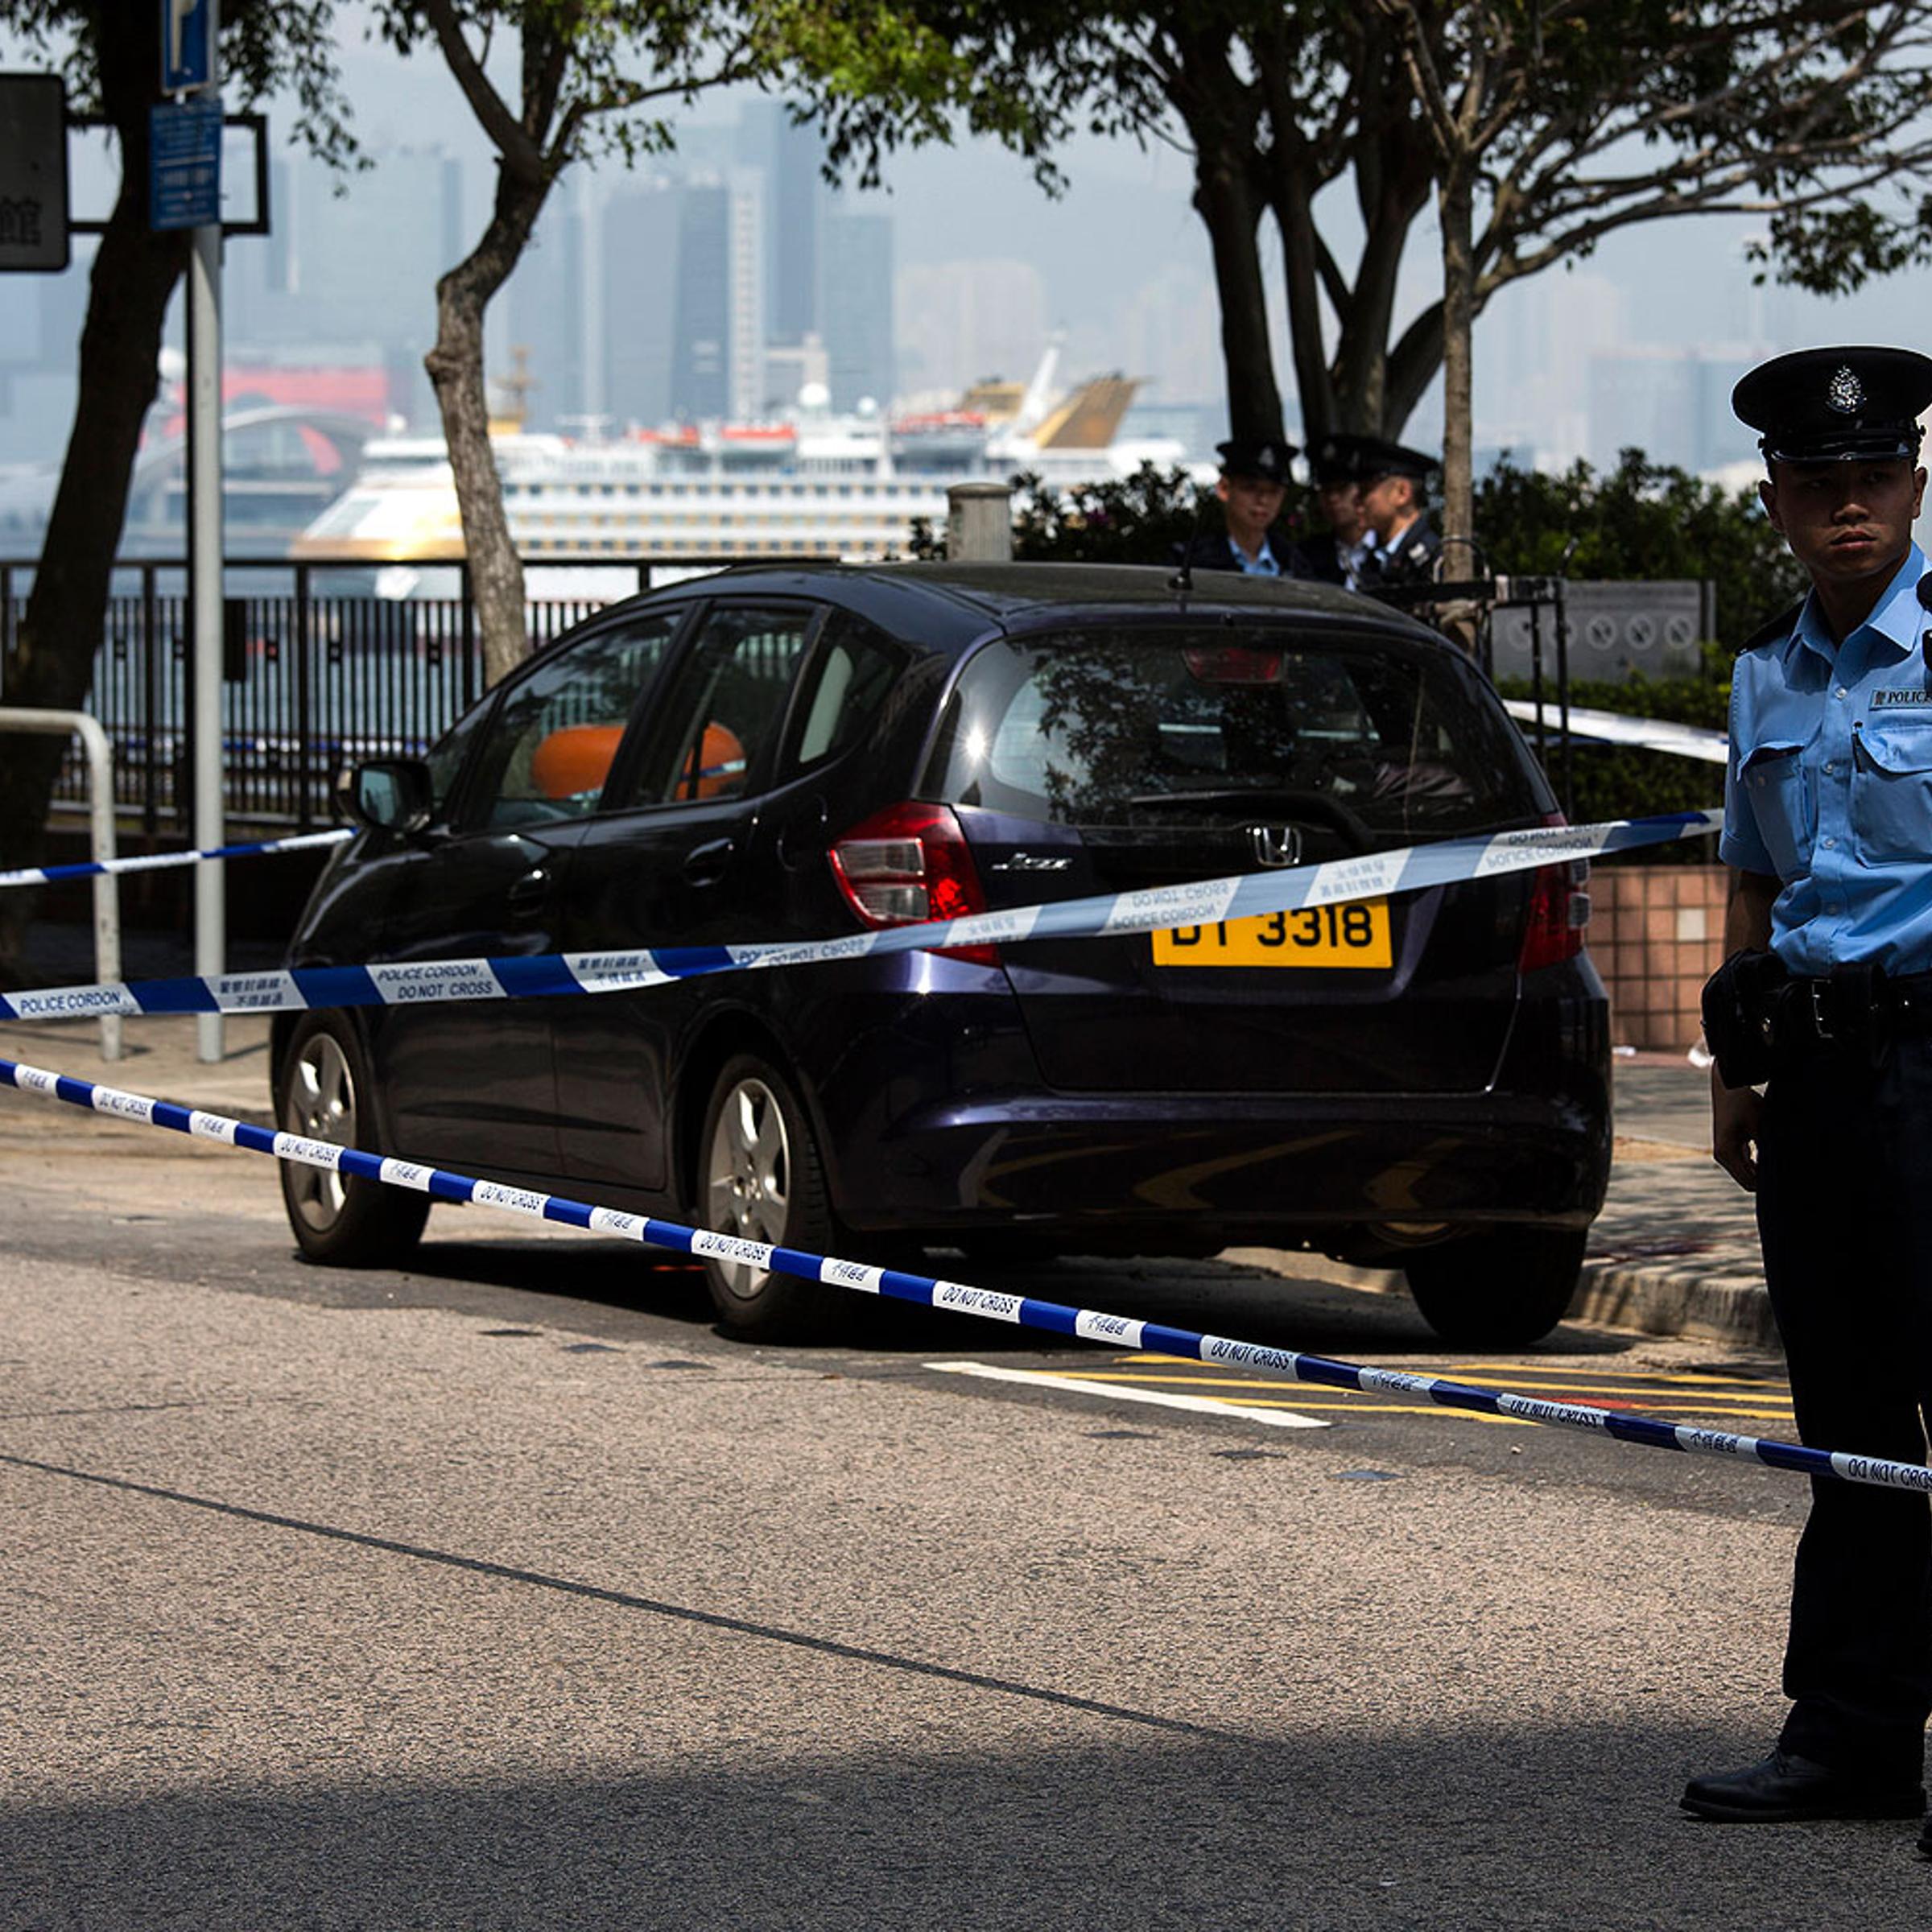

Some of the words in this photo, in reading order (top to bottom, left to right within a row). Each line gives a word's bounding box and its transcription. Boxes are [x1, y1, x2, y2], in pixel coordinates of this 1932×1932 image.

[1257, 903, 1373, 947] 3318
[378, 967, 423, 981] POLICE
[398, 985, 416, 999] DO
[419, 983, 444, 997] NOT
[449, 980, 493, 996] CROSS
[20, 995, 64, 1013] POLICE
[943, 1286, 962, 1302] DO
[959, 1290, 984, 1307] NOT
[980, 1294, 1018, 1315] CROSS
[1211, 1340, 1231, 1357] DO
[1228, 1344, 1256, 1363] NOT
[1253, 1349, 1293, 1370] CROSS
[1848, 1458, 1867, 1478] DO
[1871, 1462, 1898, 1484] NOT
